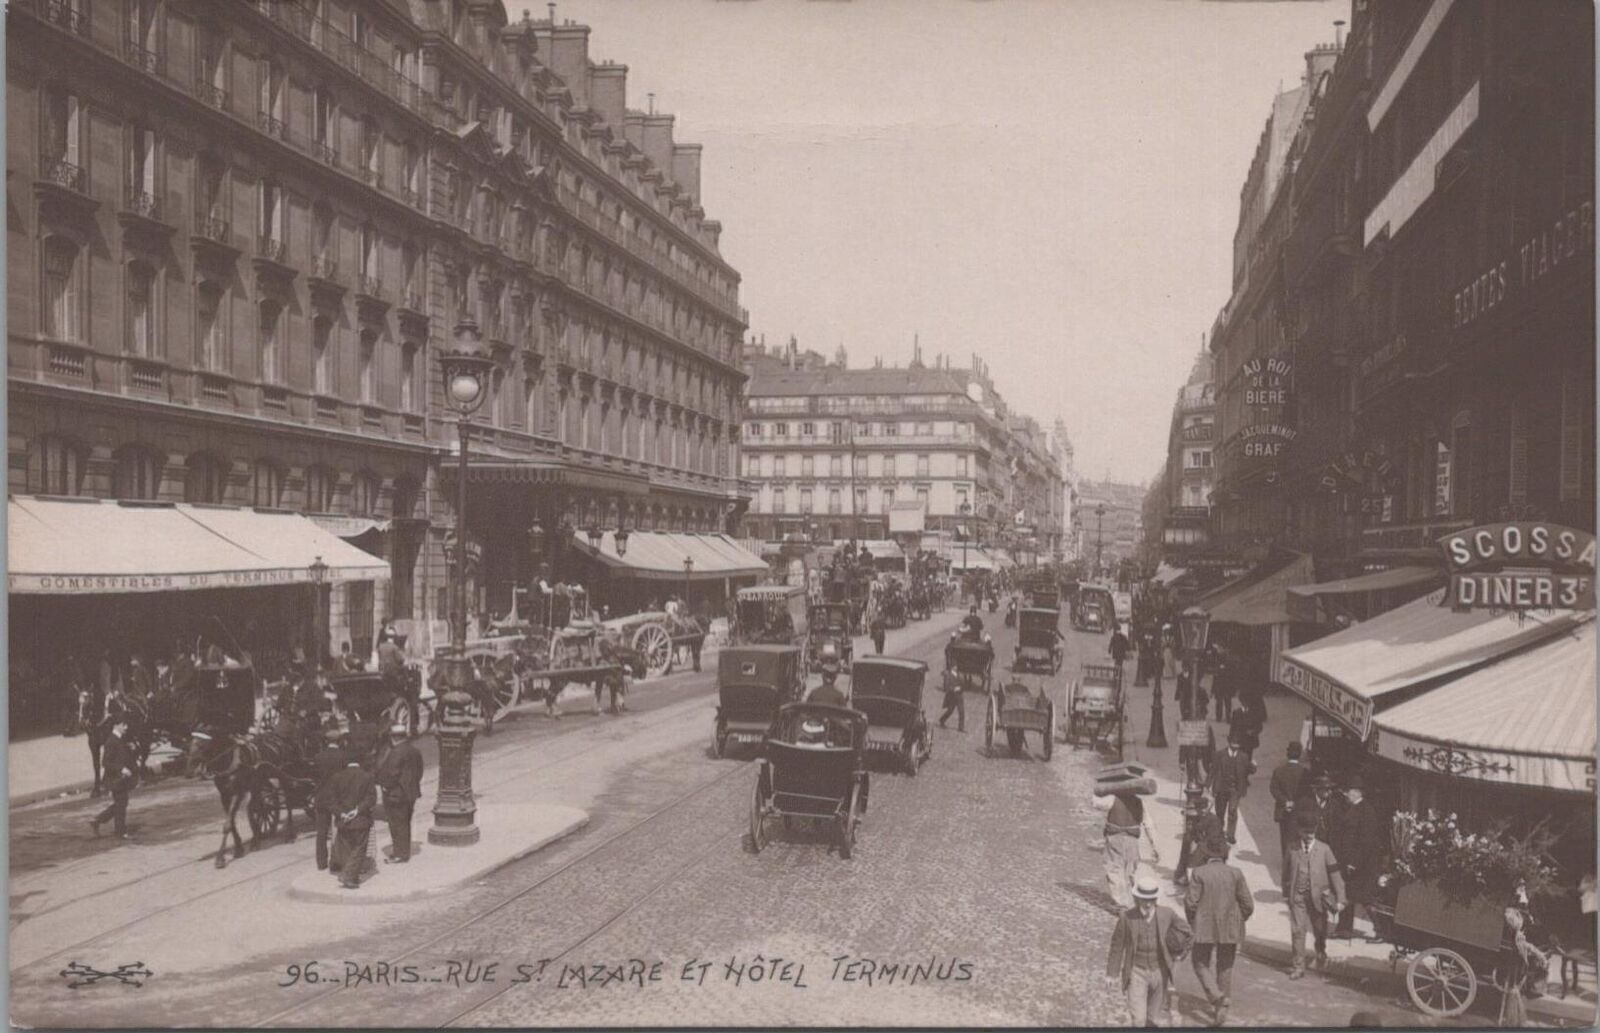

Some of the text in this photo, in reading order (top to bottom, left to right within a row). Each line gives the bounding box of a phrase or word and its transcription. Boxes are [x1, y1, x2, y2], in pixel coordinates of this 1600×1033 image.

[1453, 260, 1506, 329] RENTES
[1243, 358, 1291, 376] AU ROI
[1253, 375, 1280, 387] DE LA
[1246, 390, 1286, 404] BIERE
[1449, 526, 1596, 567] SCOSSA
[40, 574, 172, 590] COMESTIBLES
[189, 573, 208, 586] DU
[223, 569, 295, 584] TERMINUS
[1459, 576, 1553, 605] DINER
